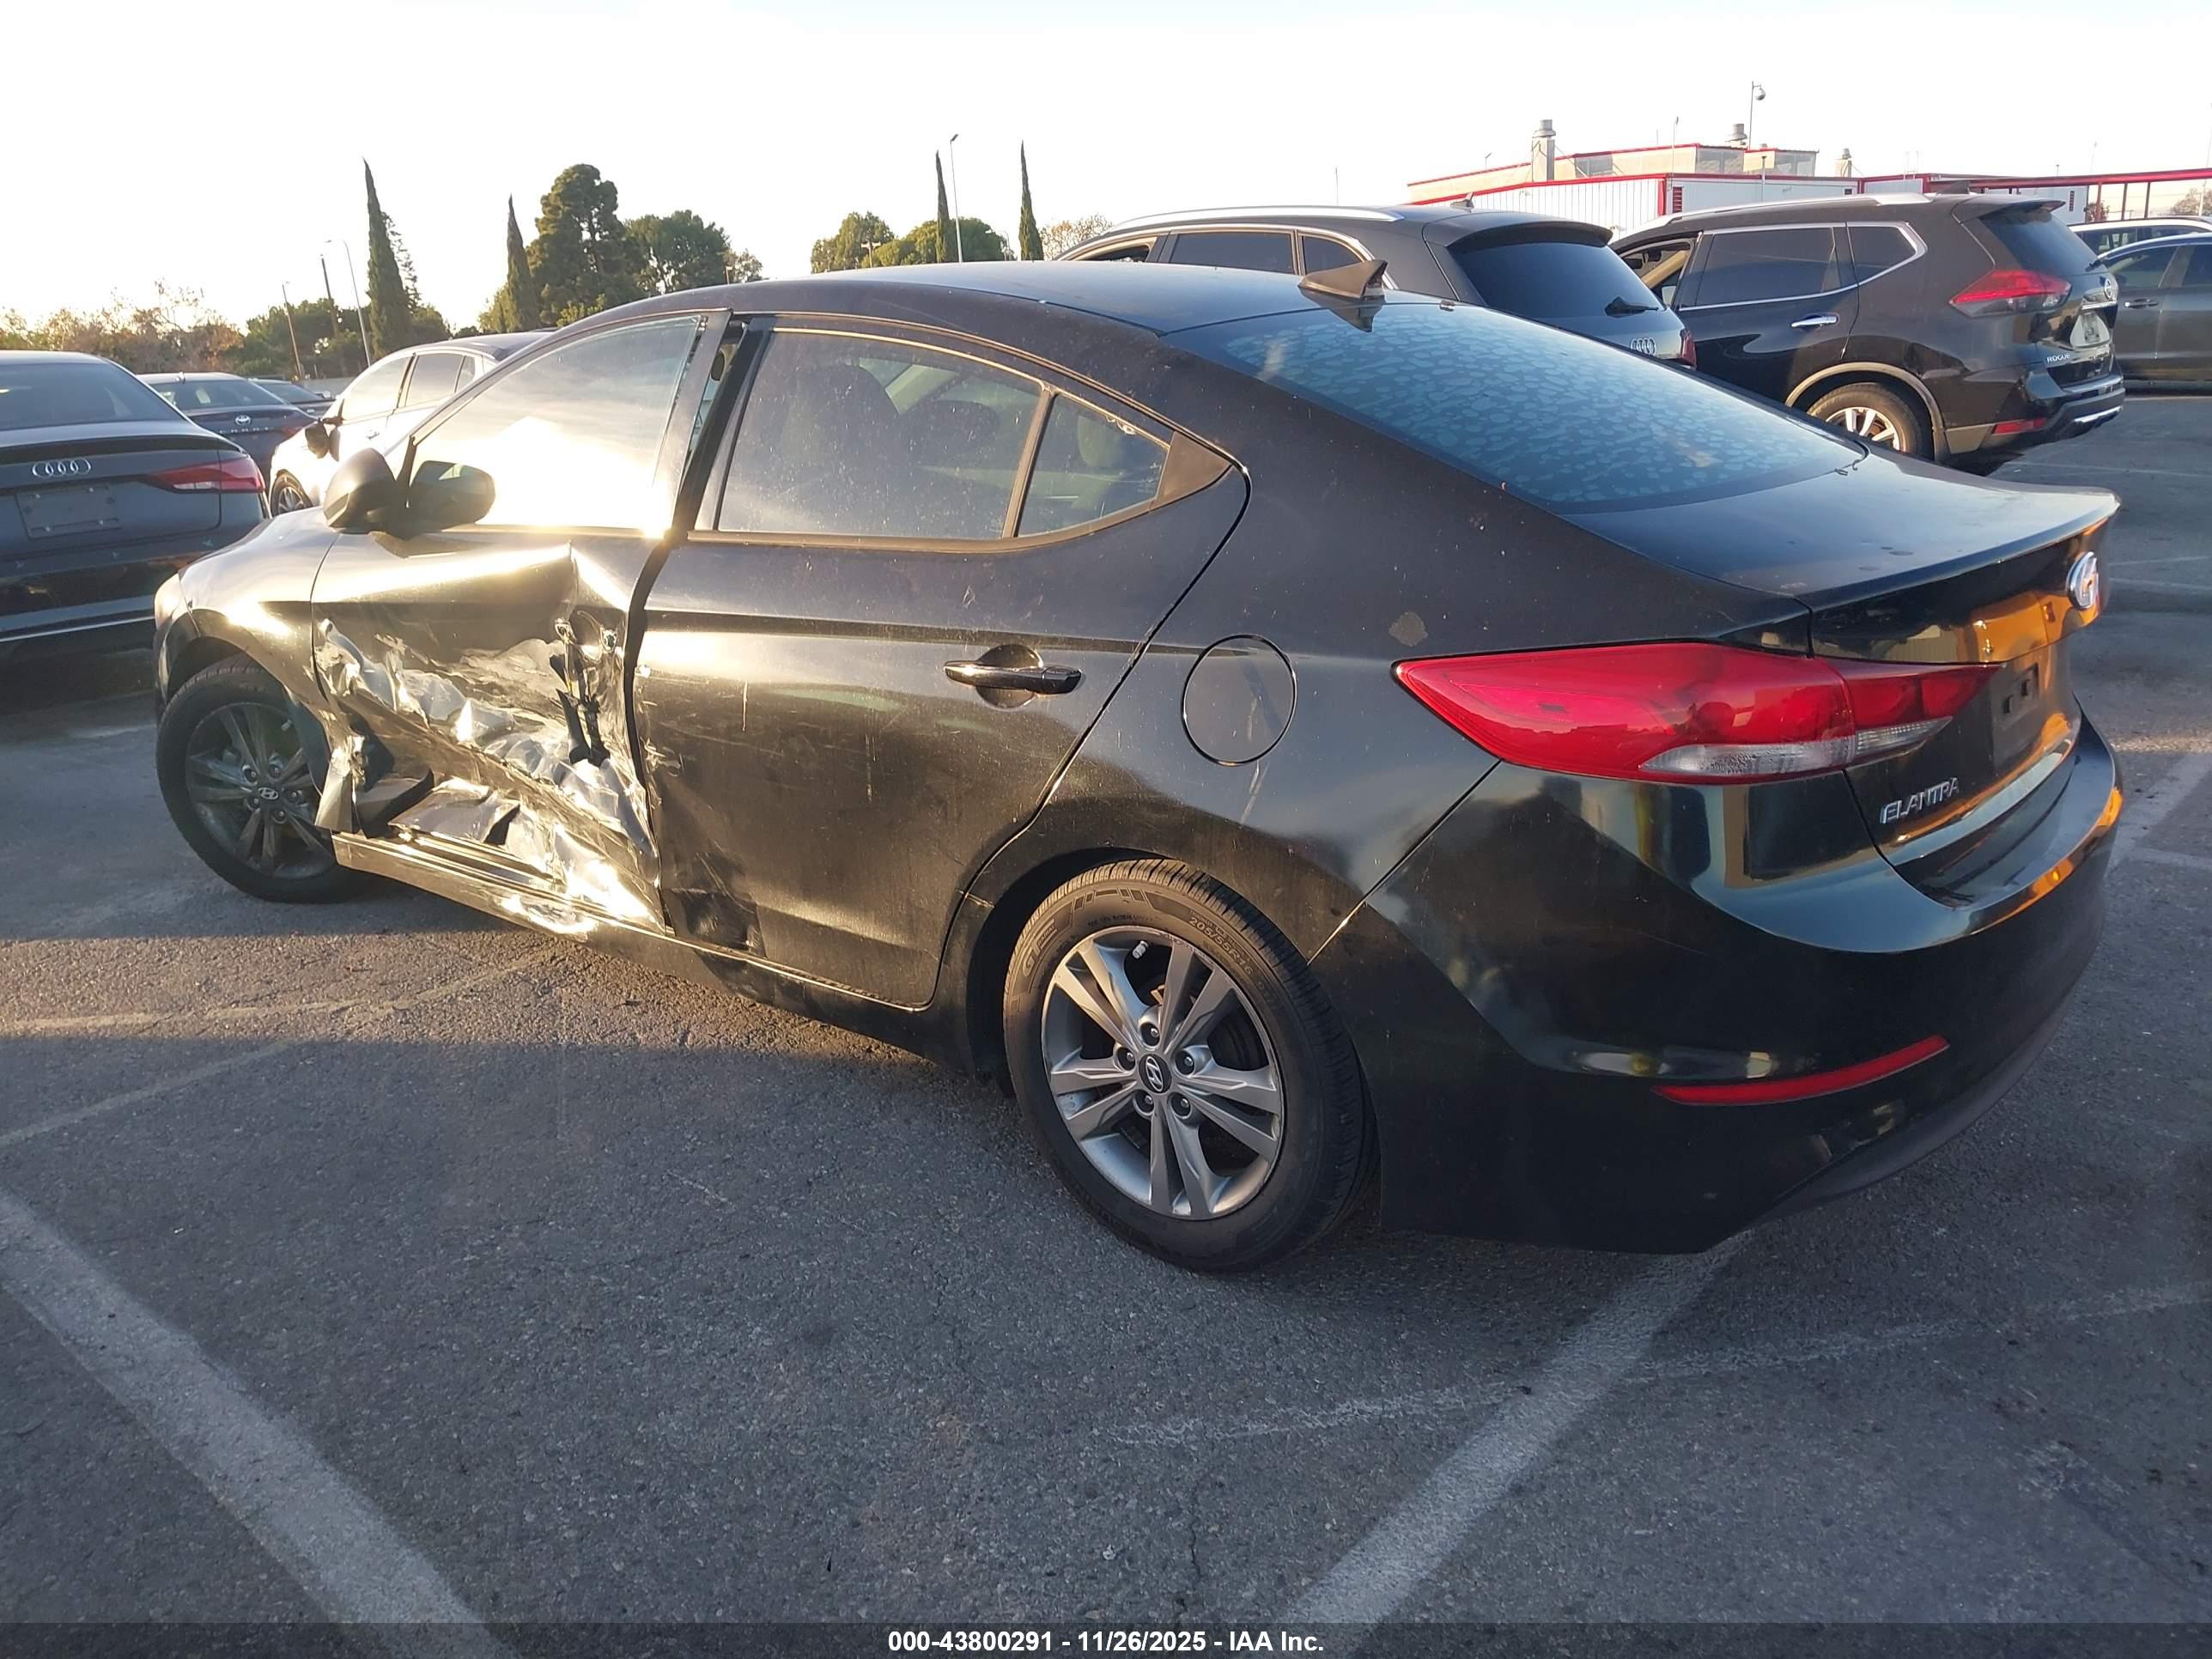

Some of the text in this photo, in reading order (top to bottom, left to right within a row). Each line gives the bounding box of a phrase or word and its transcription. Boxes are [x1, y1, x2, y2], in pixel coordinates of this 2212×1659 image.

[2046, 354, 2070, 363] ROGUE
[1880, 777, 1959, 824] ELANTRA
[1188, 916, 1254, 975] 205/55R16
